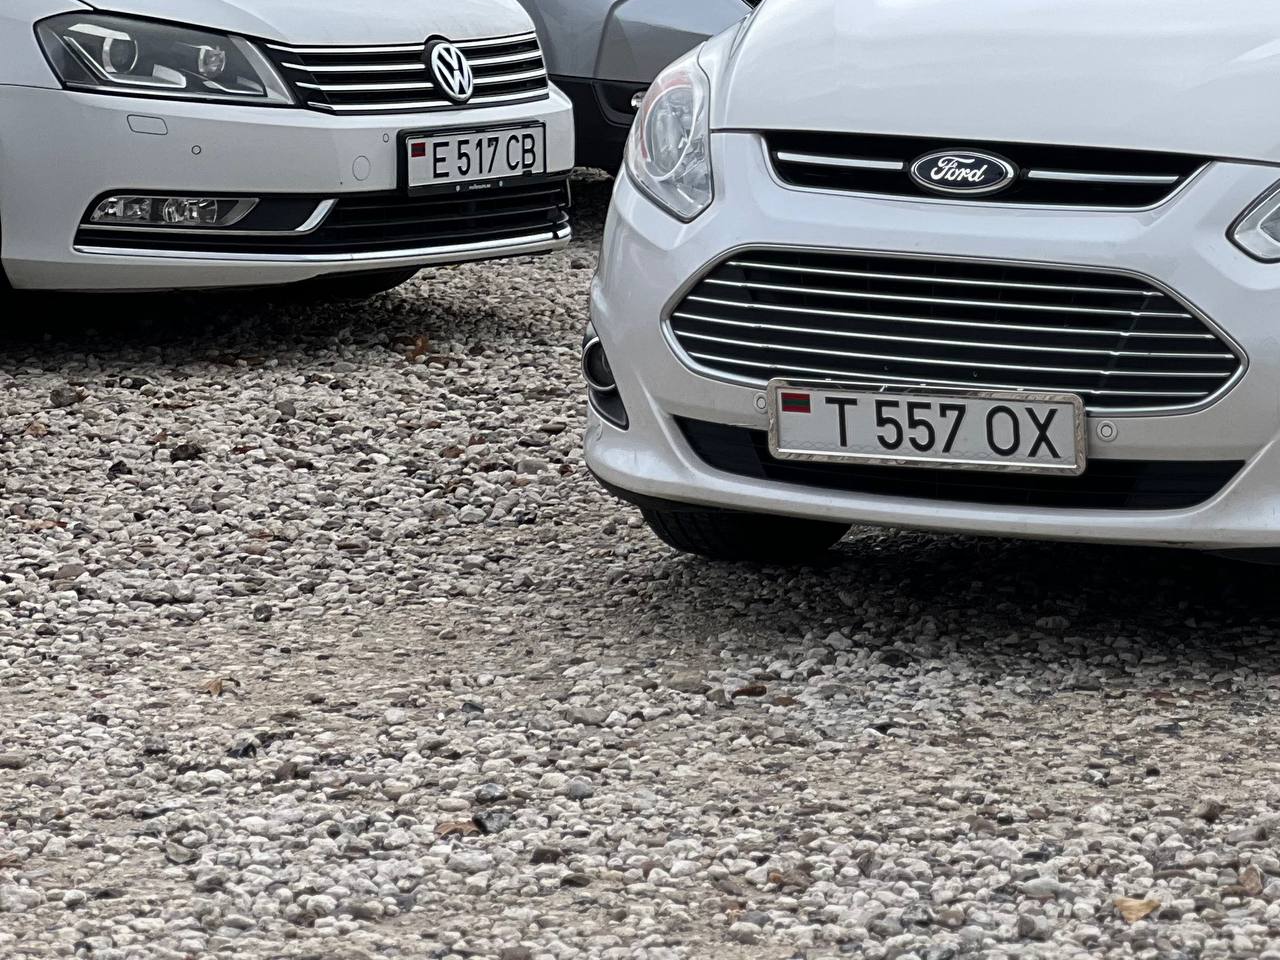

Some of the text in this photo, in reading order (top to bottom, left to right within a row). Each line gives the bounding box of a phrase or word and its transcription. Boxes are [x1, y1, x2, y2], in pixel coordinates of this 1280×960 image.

[432, 133, 536, 179] E 517 CB
[930, 156, 988, 182] Ford
[824, 396, 1062, 459] T 557 OX
